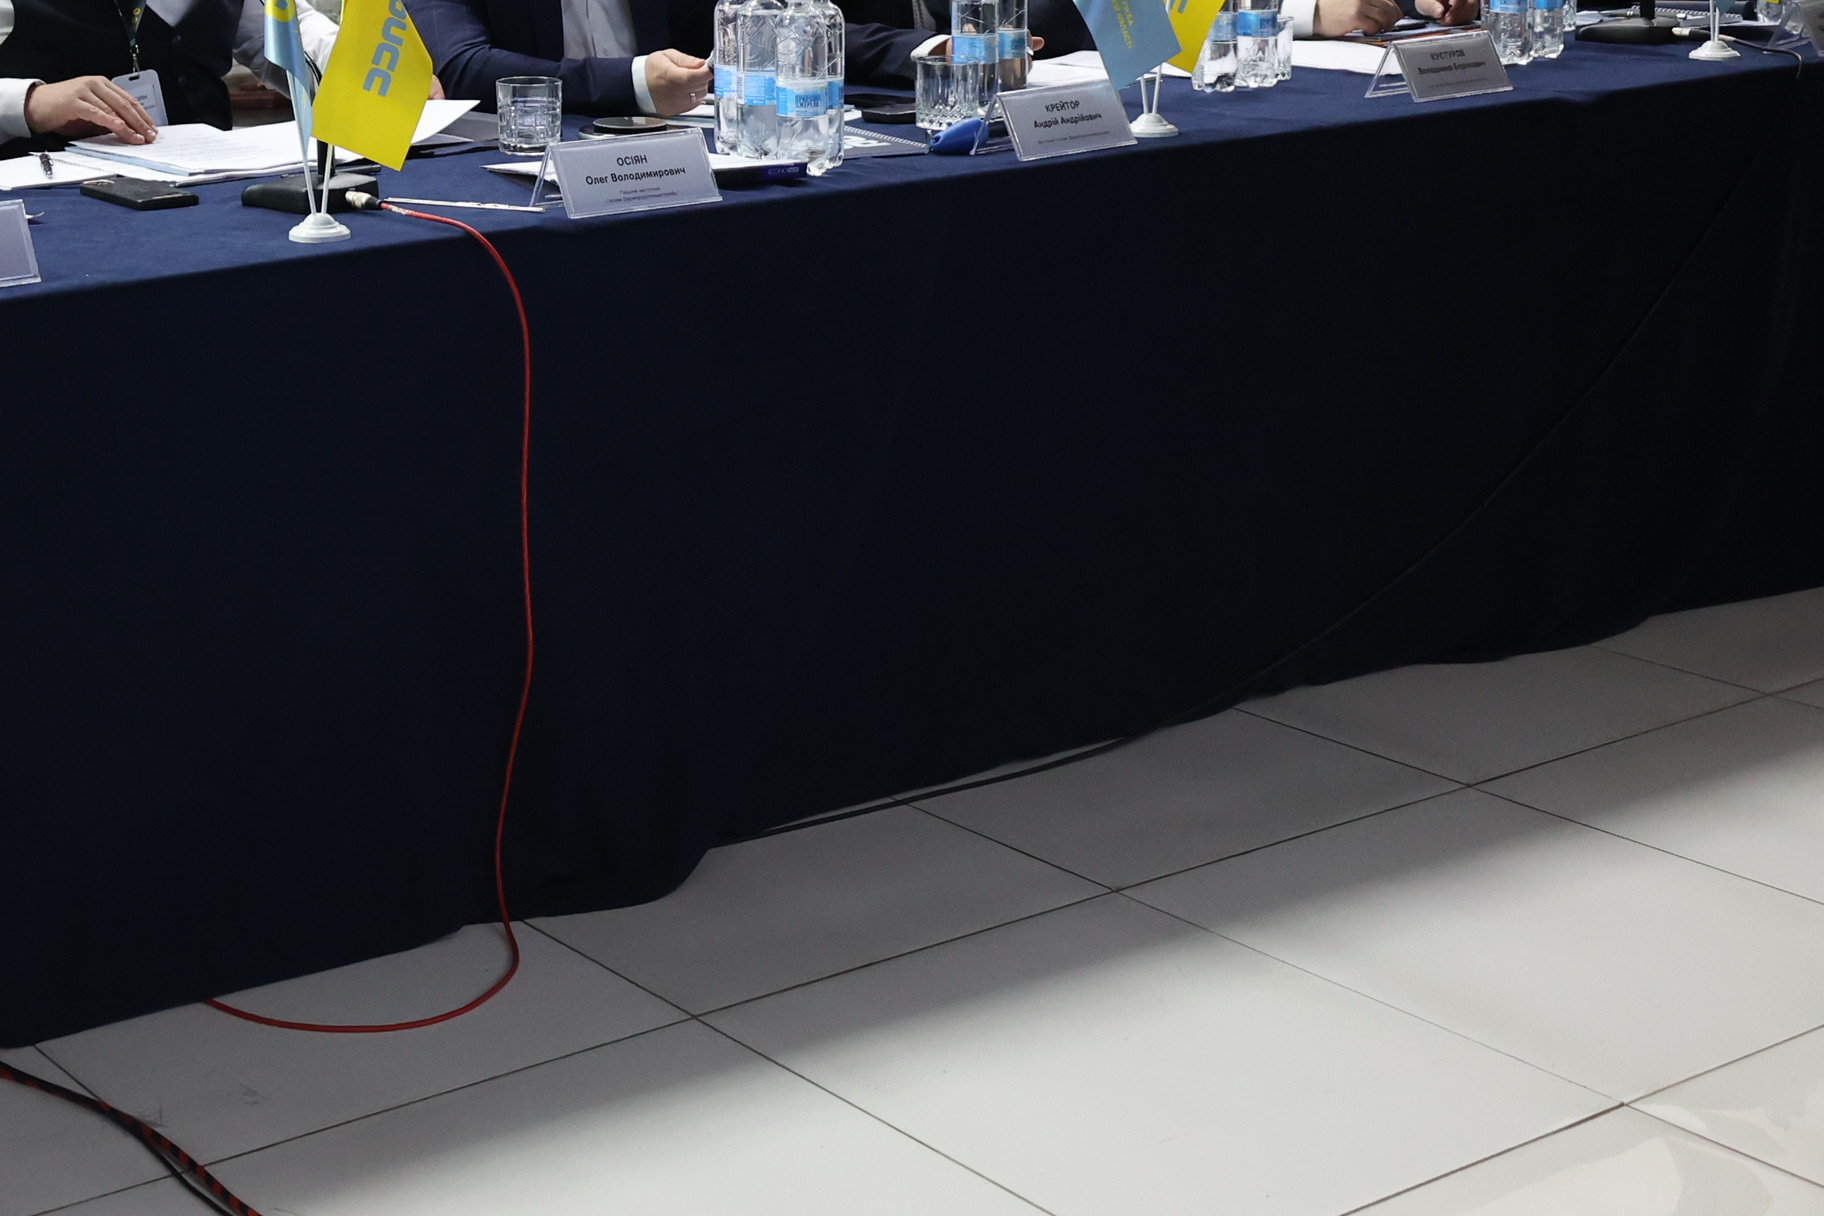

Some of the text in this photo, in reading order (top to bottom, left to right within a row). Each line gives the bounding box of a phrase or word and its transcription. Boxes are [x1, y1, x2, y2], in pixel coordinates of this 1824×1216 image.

[1044, 100, 1080, 113] КРЕЙТОР
[1033, 115, 1060, 130] Андрій
[615, 154, 649, 169] ОСІЯН
[585, 166, 687, 187] Олег Володимирович
